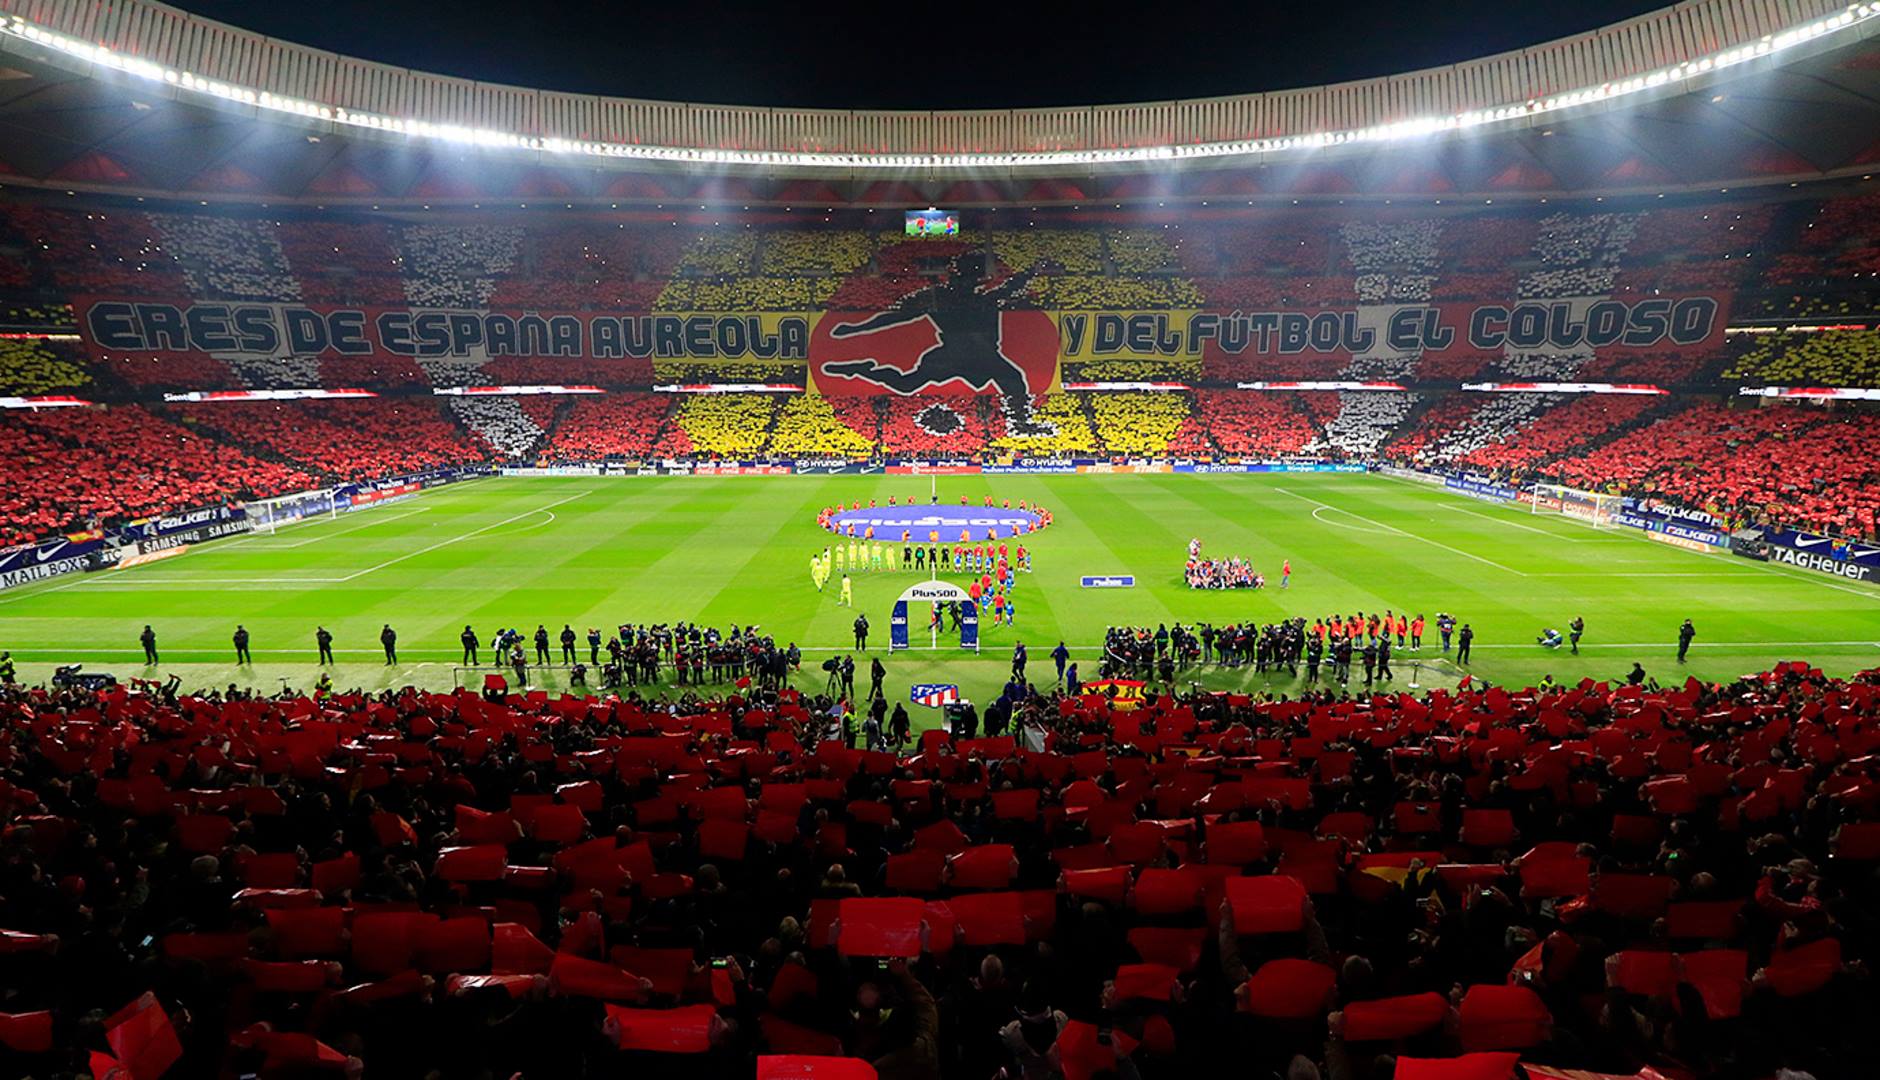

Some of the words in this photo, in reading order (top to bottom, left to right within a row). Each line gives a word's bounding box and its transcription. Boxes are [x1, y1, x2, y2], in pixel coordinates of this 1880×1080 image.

[87, 301, 280, 352] ERES
[282, 307, 373, 354] DE
[589, 315, 808, 359] AUREOLA
[1063, 313, 1087, 355] Y
[1092, 312, 1184, 355] DEL
[1187, 309, 1376, 355] FÚTBOL
[1386, 306, 1456, 351] EL
[1468, 297, 1718, 349] COLOSO
[2, 566, 46, 586] MAIL
[912, 589, 957, 598] Plus500
